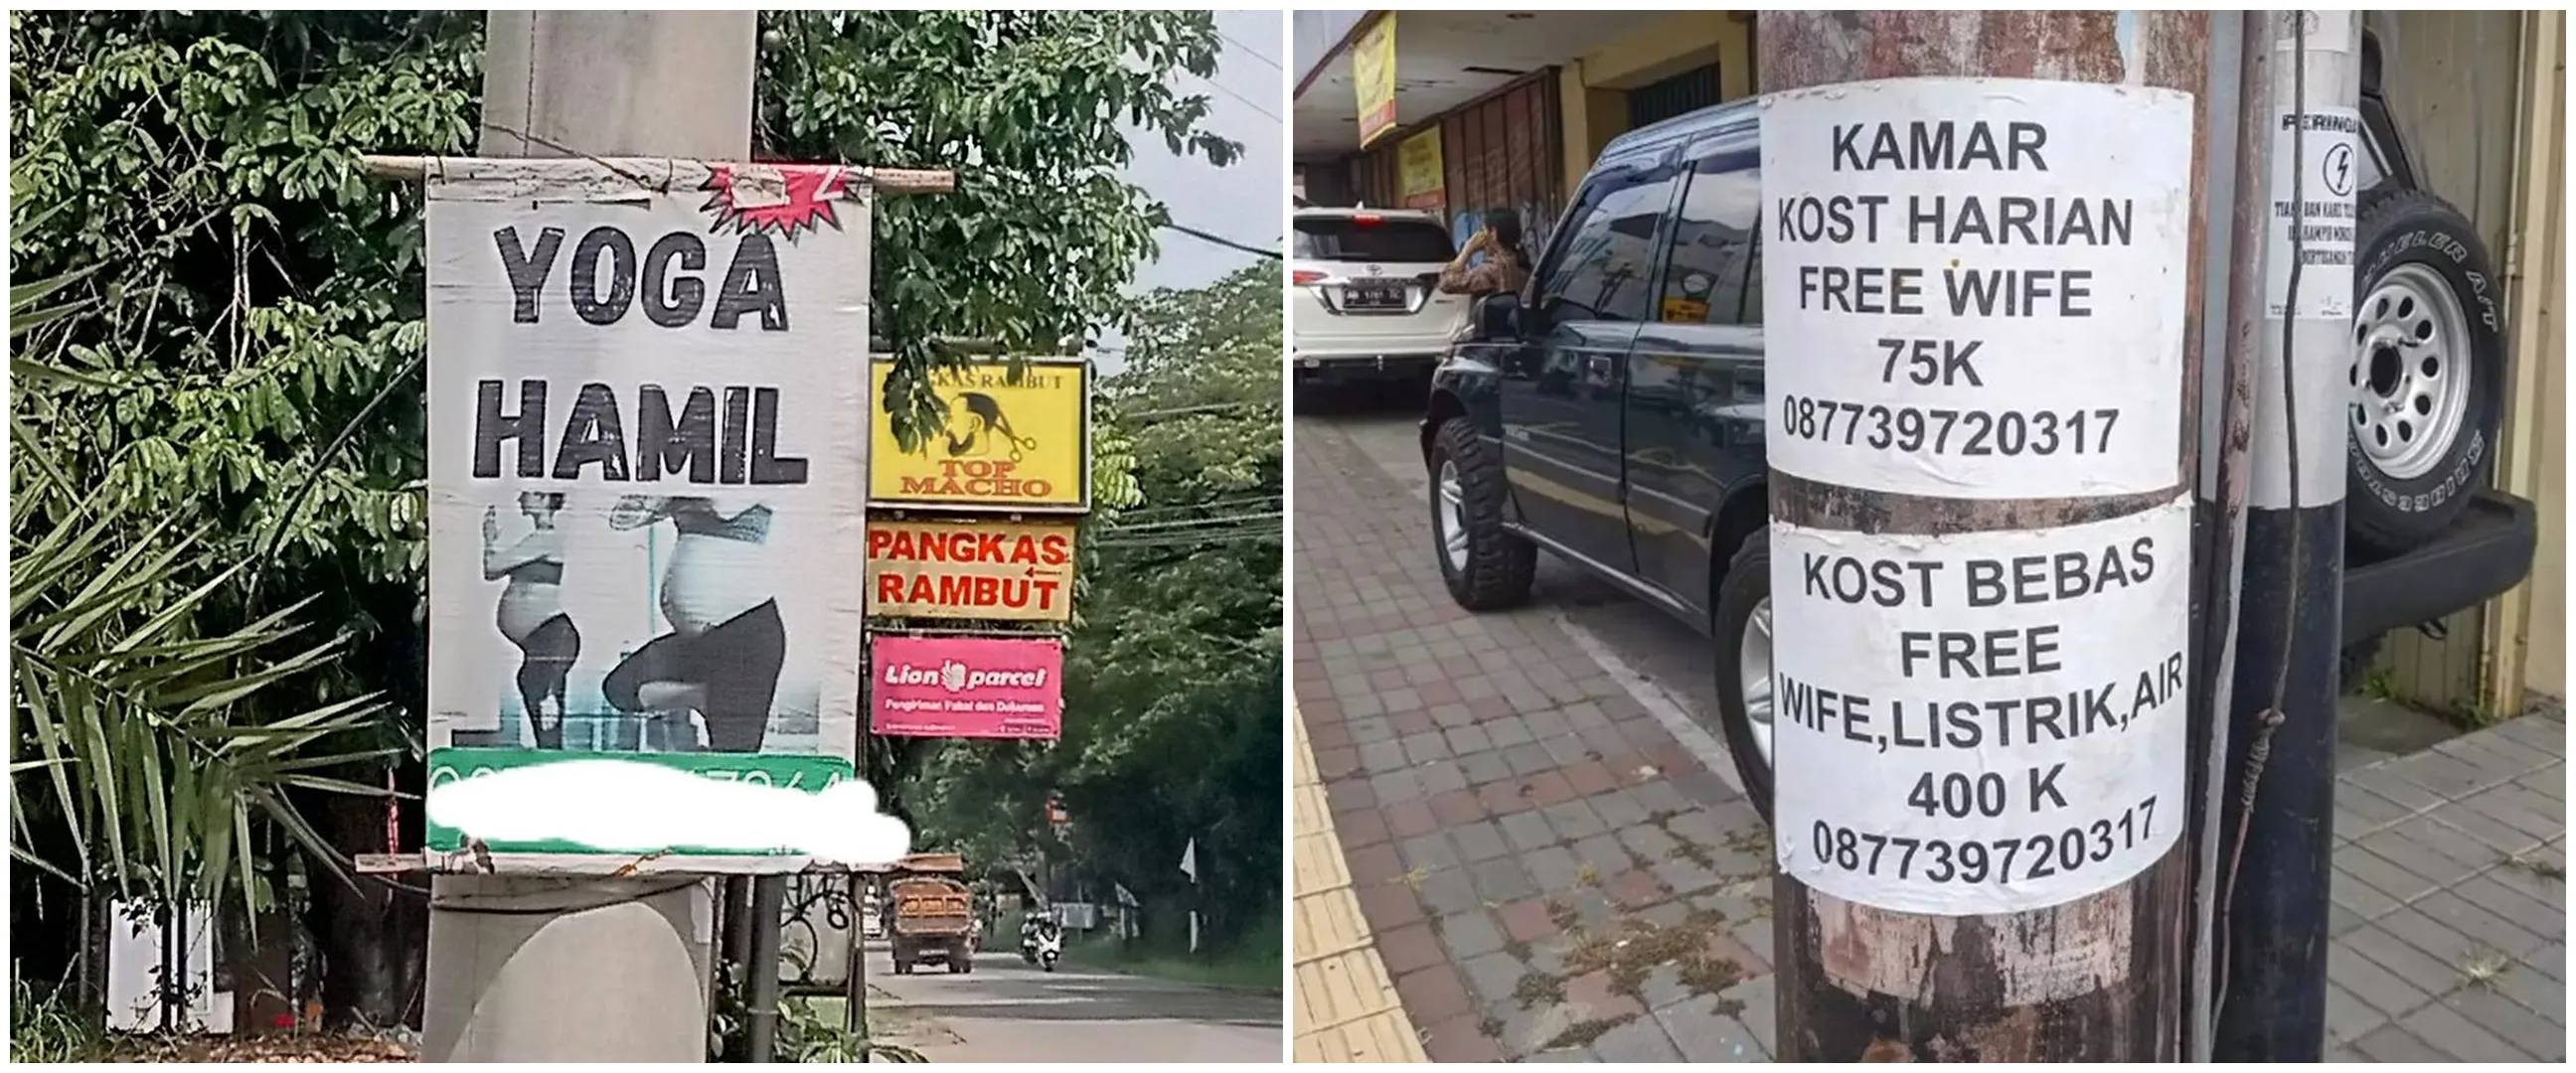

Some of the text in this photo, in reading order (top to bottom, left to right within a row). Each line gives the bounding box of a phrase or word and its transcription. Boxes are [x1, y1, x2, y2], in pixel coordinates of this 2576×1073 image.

[1833, 120, 2048, 172] KAMAR
[1779, 195, 2134, 246] KOST HARIAN
[493, 225, 789, 332] YOGA
[1799, 265, 2093, 318] FREE WIFE
[1877, 338, 1984, 387] 75K
[472, 379, 809, 486] HAMIL
[1783, 393, 2120, 457] 087739720317
[899, 477, 1052, 498] MACHO
[938, 460, 1017, 478] TOP
[868, 529, 1067, 565] PANGKAS
[1803, 536, 2156, 608] KOST BEBAS
[878, 573, 1060, 611] RAMBUT
[885, 664, 1047, 690] Lion parcel
[1900, 625, 2062, 679] FREE
[1779, 651, 2183, 753] WIFE,LISTRIK,AIR
[1907, 762, 2068, 820] 400 K
[1812, 795, 2158, 885] 087739720317
